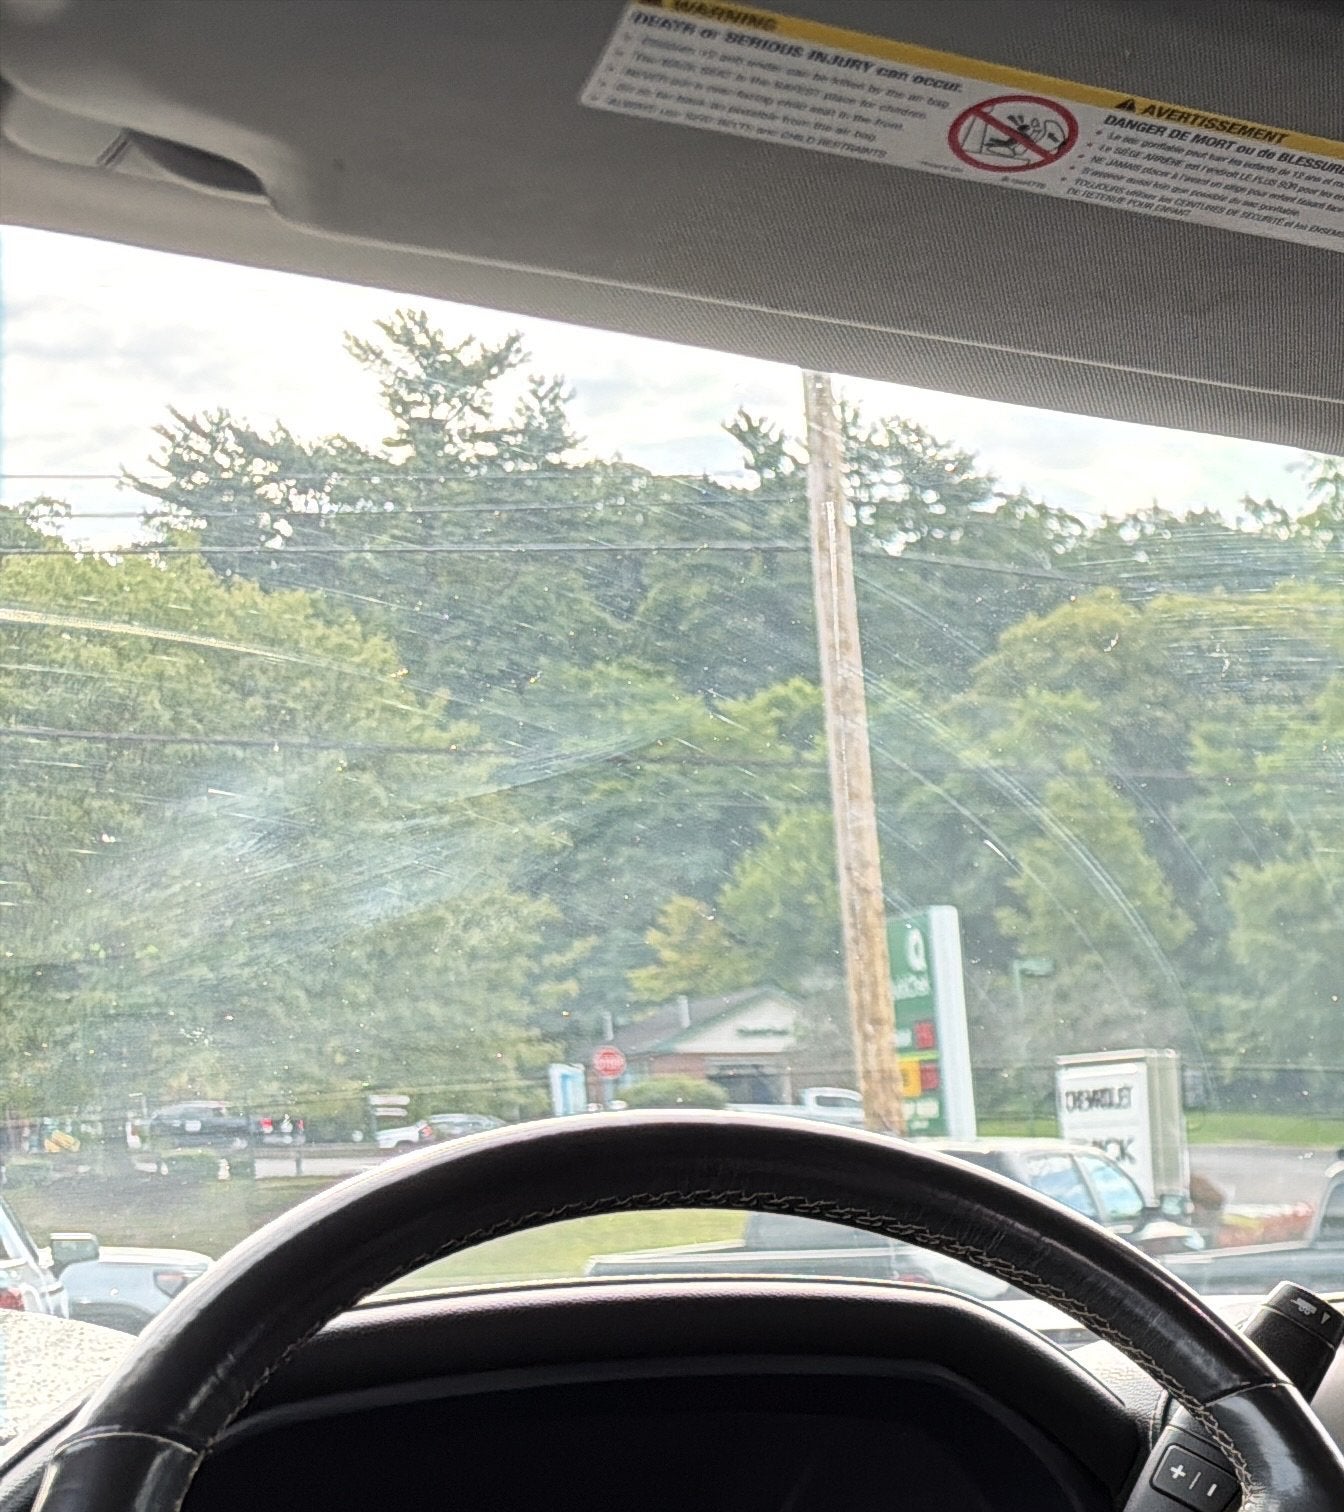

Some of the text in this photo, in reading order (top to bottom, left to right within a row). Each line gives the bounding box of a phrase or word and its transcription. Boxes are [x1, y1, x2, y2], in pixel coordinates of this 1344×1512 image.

[672, 0, 779, 32] WARNING
[631, 10, 699, 35] DEATH
[698, 25, 721, 40] or
[722, 30, 805, 58] SERIOUS
[804, 48, 876, 73] INJURY
[873, 64, 912, 81] can
[909, 72, 967, 93] occur.
[1102, 113, 1169, 136] DANGER
[1166, 127, 1193, 141] DE
[1188, 132, 1238, 151] MORT
[1233, 142, 1258, 155] ou
[1254, 147, 1279, 160] de
[1140, 102, 1288, 145] AVERTISSEMENT
